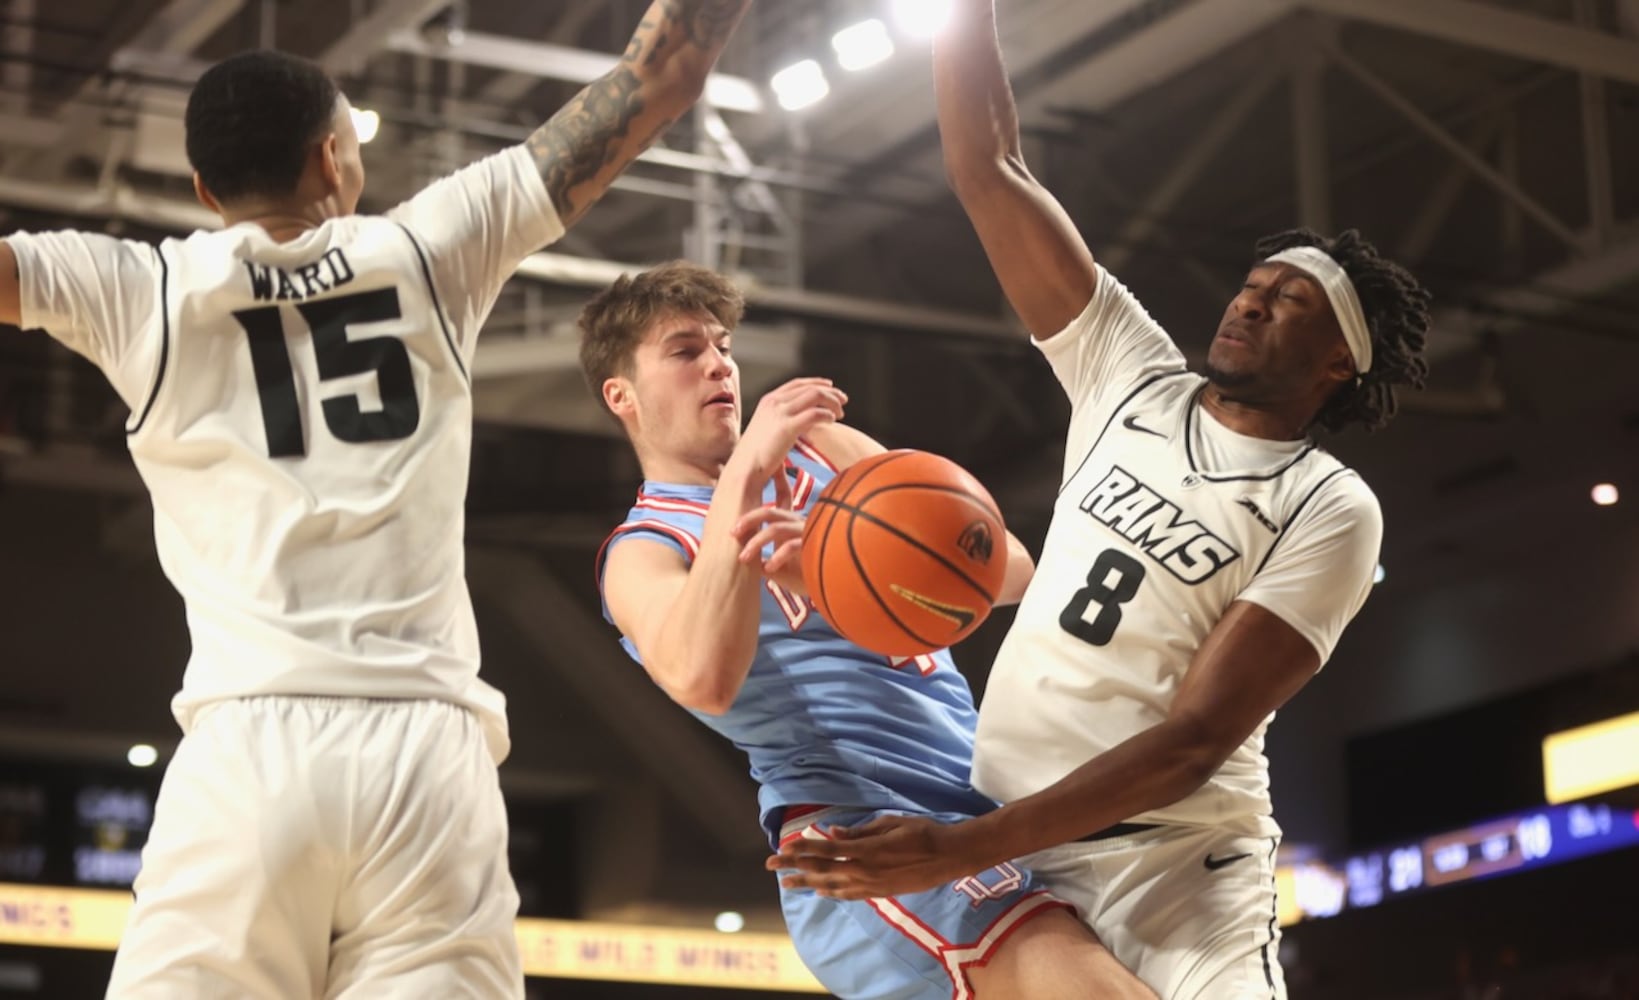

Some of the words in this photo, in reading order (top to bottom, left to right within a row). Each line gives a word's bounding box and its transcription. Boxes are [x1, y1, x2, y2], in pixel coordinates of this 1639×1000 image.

[243, 246, 355, 302] WARD
[230, 286, 420, 459] 15
[1078, 464, 1241, 586] RAMS
[1059, 547, 1147, 647] 8
